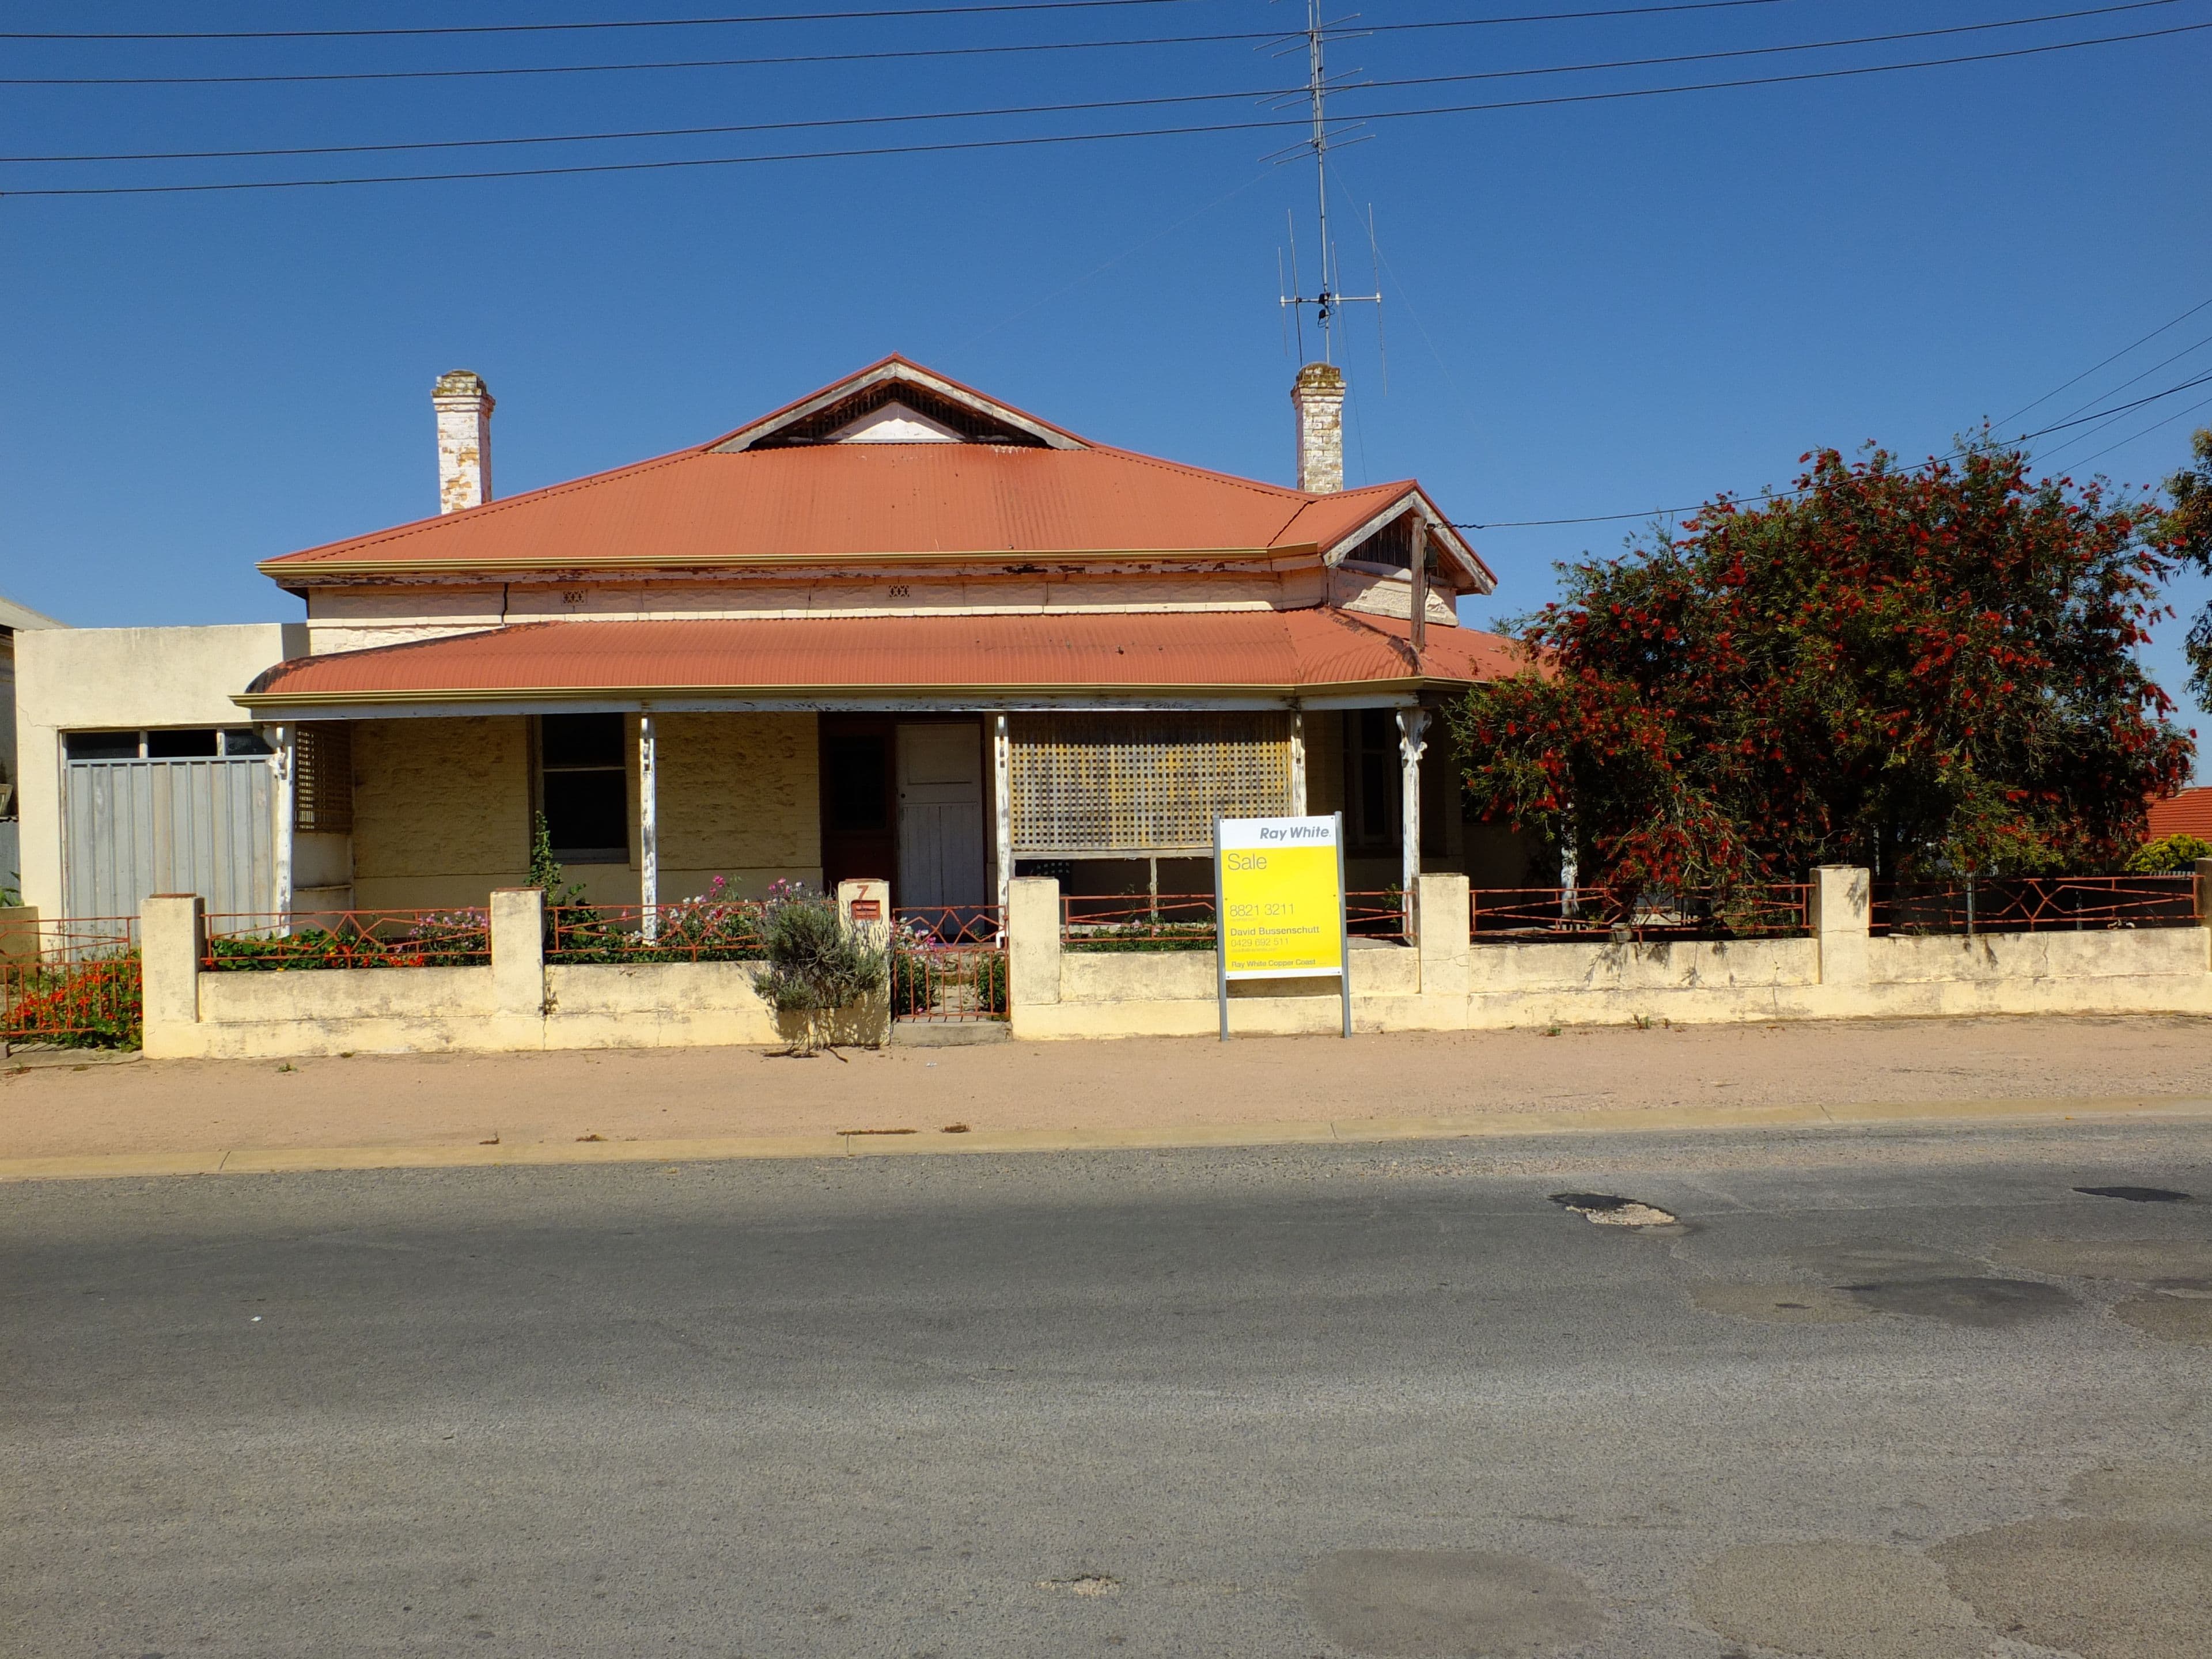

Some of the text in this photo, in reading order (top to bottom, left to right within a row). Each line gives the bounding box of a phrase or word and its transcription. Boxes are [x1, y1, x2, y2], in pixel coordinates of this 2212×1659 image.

[1259, 826, 1330, 841] Ray White
[1228, 853, 1267, 870] Sale
[857, 885, 869, 900] 7
[1230, 903, 1294, 916] 8821 3211
[1230, 926, 1320, 936] David Bussenschutt
[1230, 938, 1252, 947] 0429
[1274, 937, 1289, 945] 511
[1268, 959, 1294, 967] Copper
